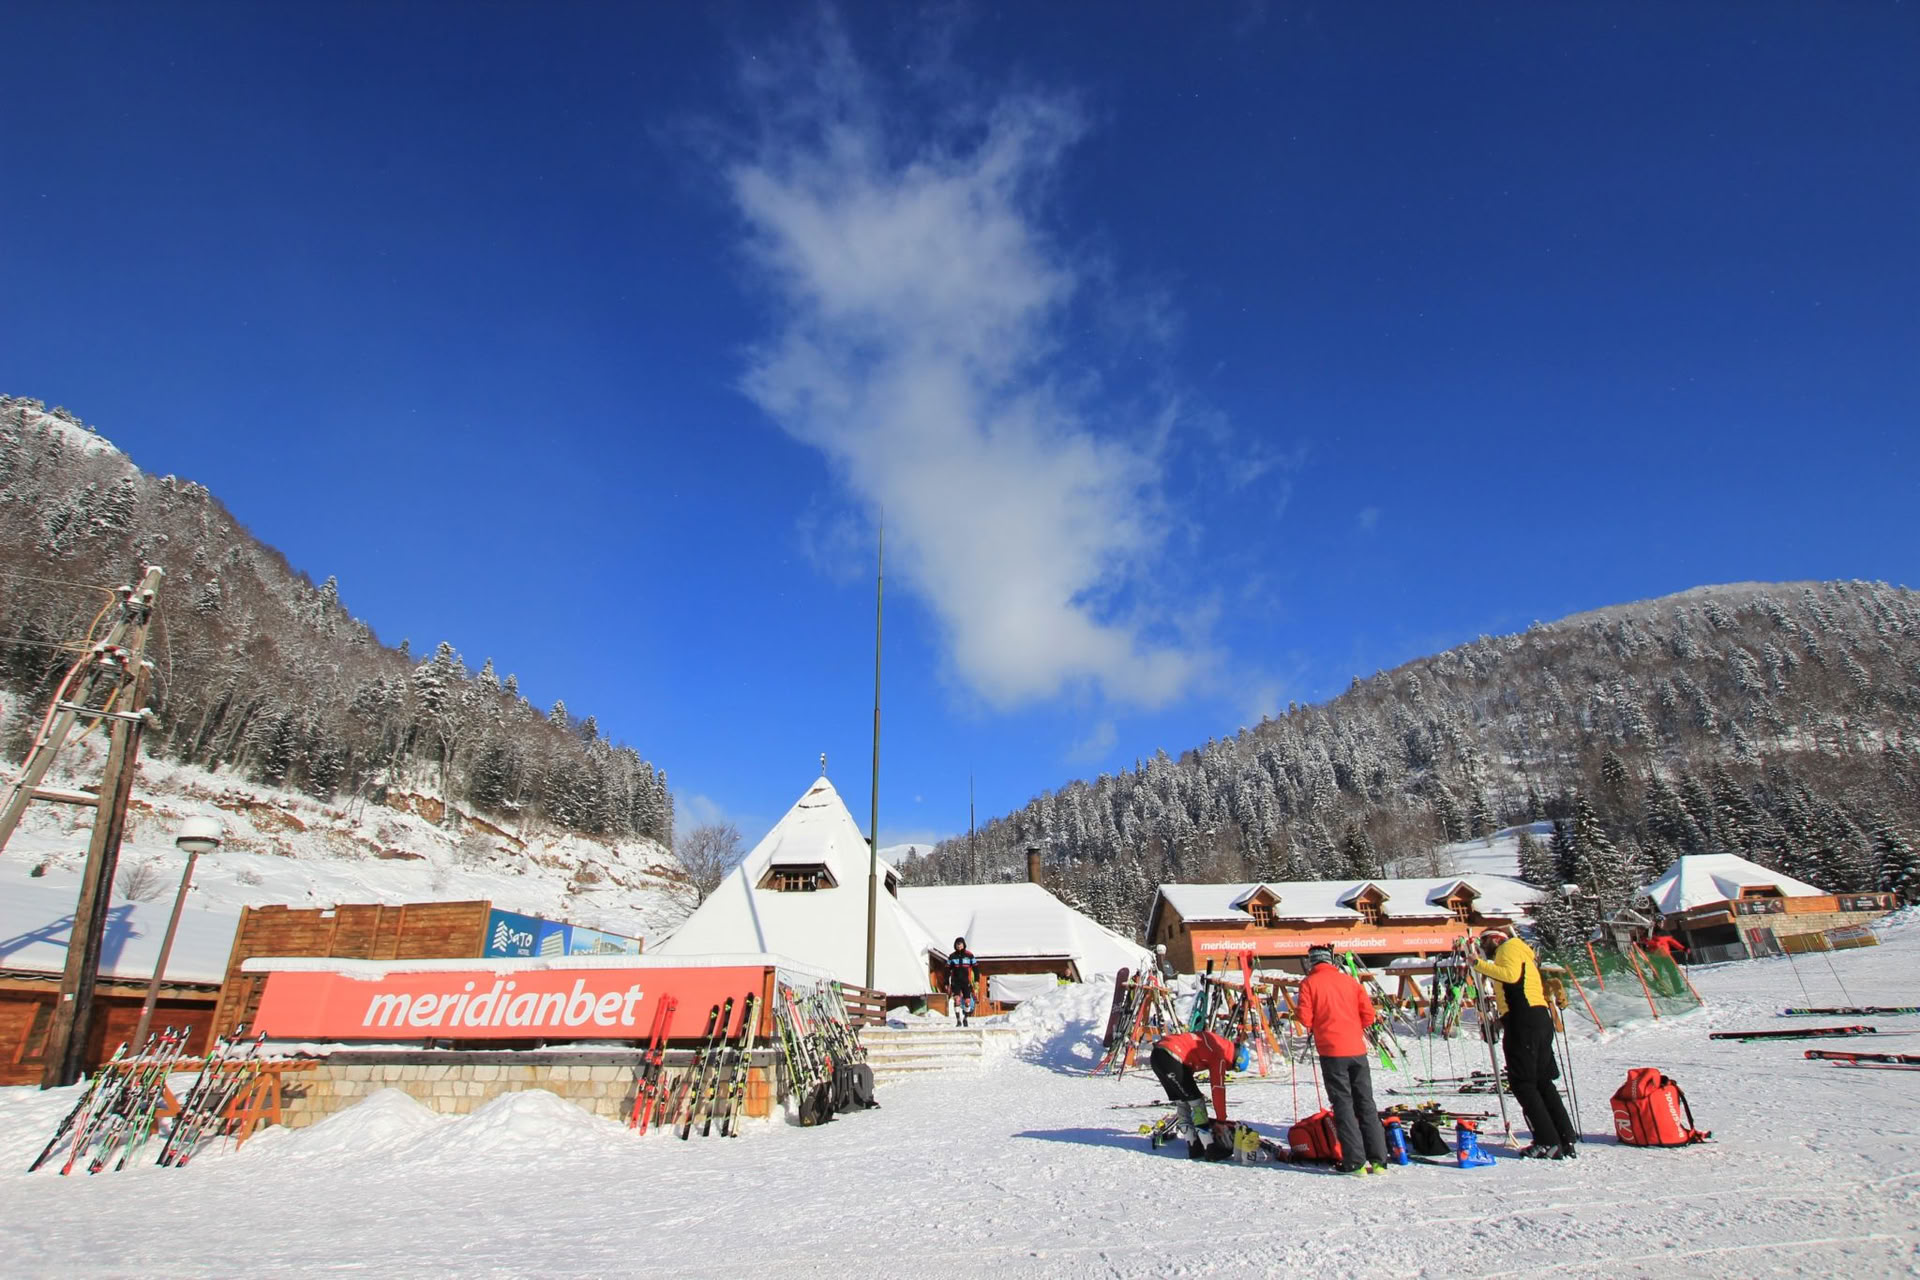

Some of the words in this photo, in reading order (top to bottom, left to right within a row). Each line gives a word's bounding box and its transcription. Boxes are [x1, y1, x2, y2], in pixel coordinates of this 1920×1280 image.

[1200, 940, 1257, 950] meridianbet
[1331, 938, 1387, 948] meridianbet
[362, 979, 643, 1027] meridianbet
